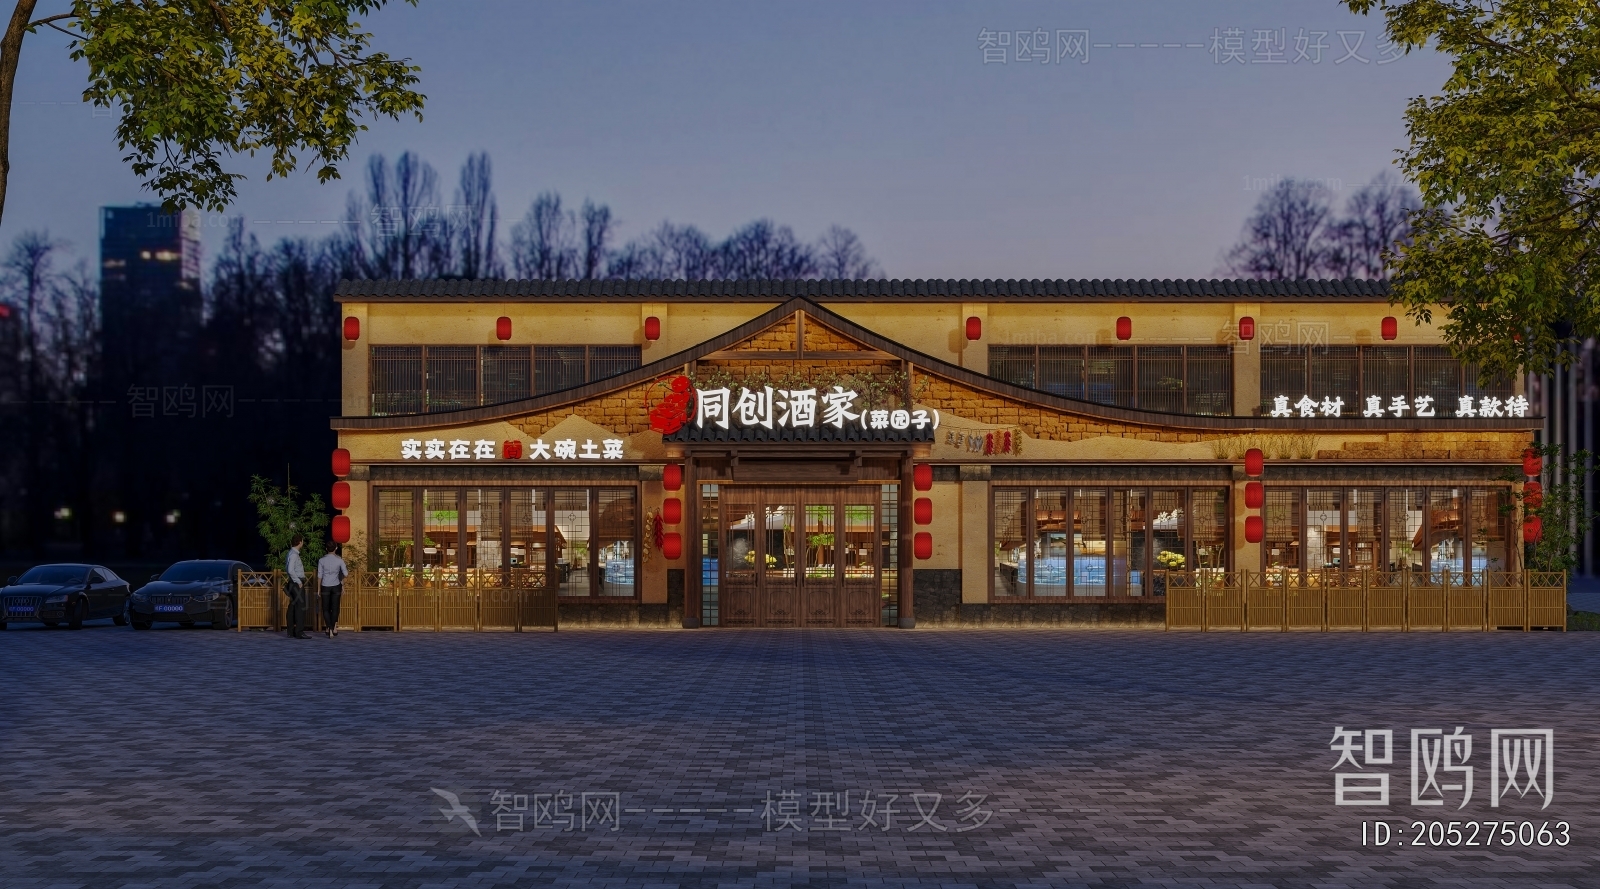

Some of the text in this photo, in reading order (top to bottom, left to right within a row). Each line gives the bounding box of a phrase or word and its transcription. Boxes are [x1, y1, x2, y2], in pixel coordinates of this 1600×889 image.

[695, 386, 940, 431] 同创酒家 (菜园子)
[1271, 395, 1529, 418] 真食材 真手艺 真款待
[401, 438, 624, 460] 实实在在 大碗土菜
